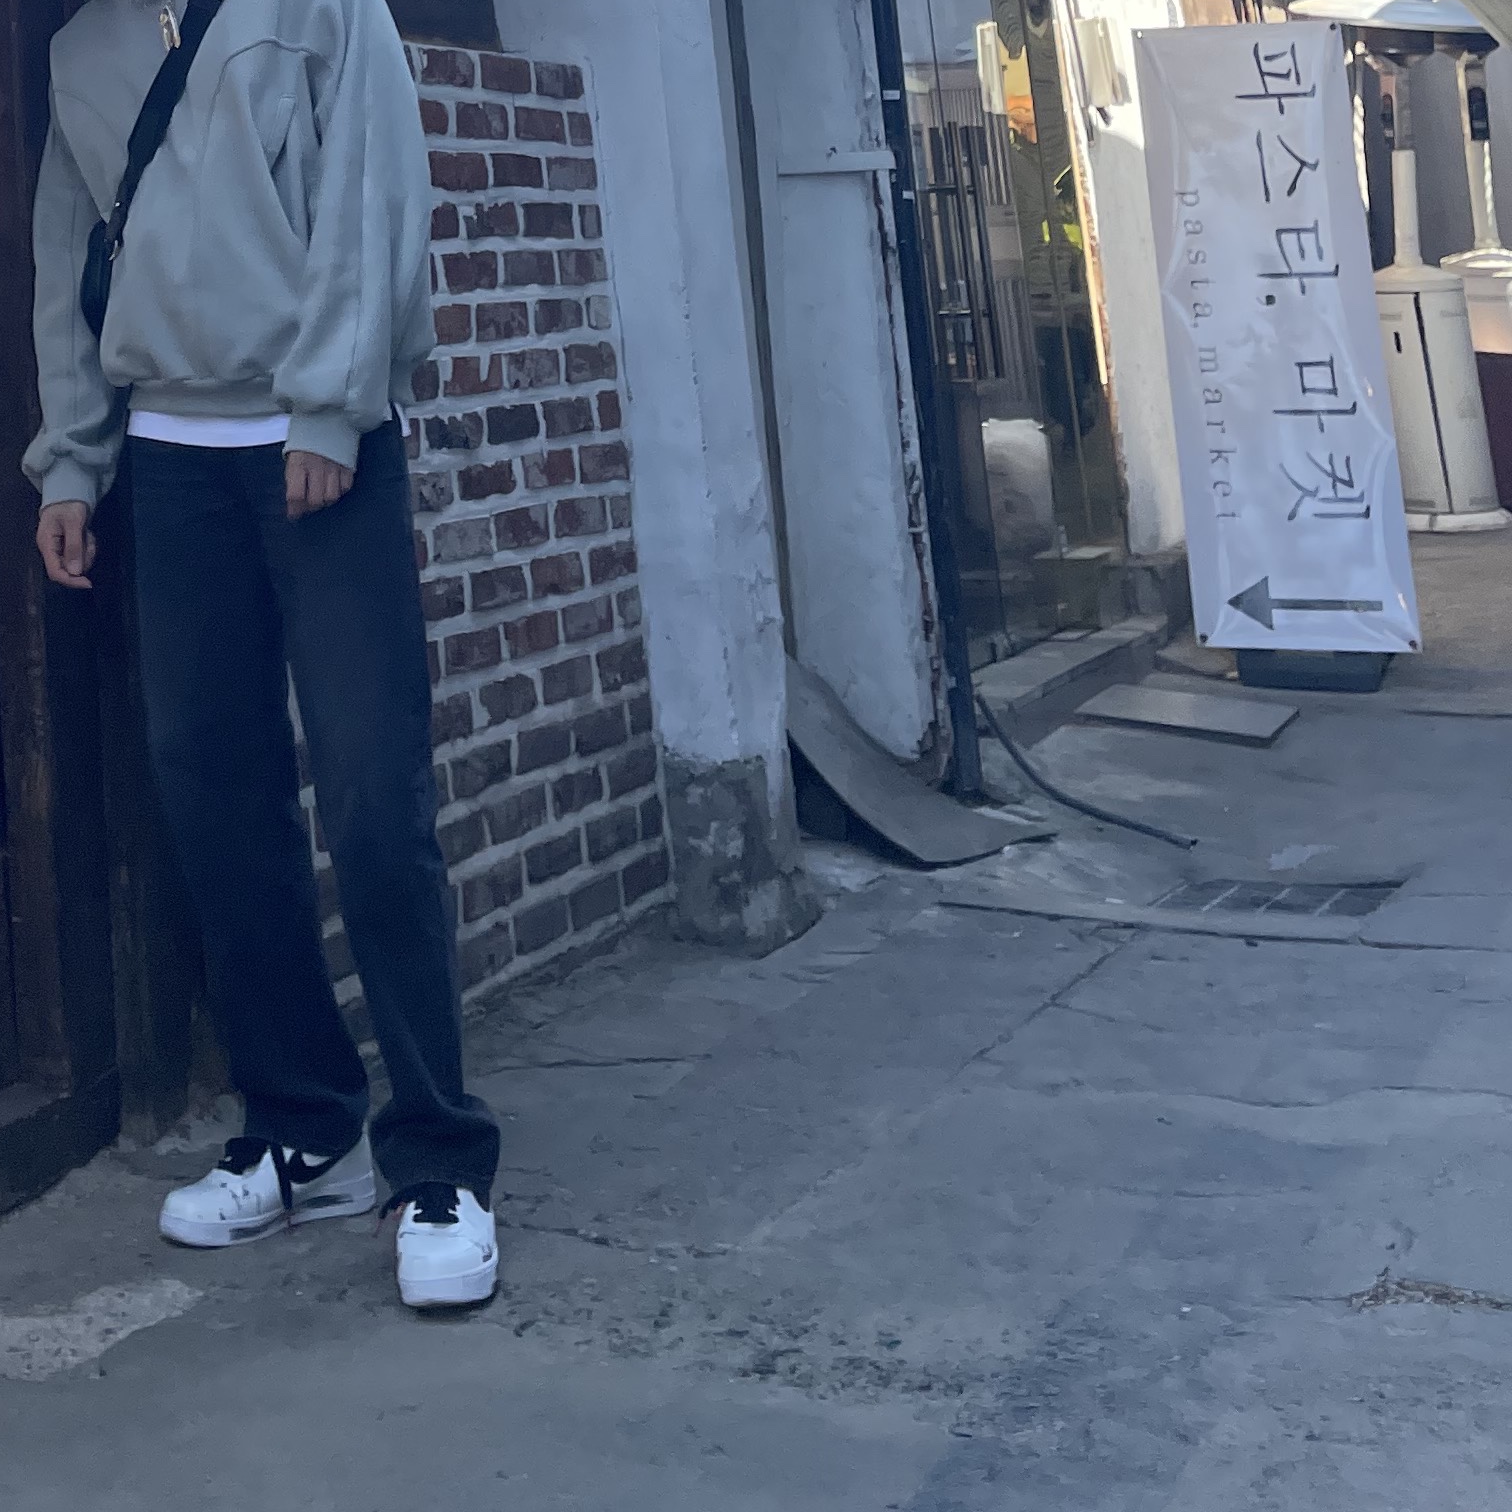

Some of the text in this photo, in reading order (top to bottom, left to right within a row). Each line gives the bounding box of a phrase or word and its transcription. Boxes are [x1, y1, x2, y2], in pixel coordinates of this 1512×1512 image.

[1198, 347, 1242, 519] market
[1234, 41, 1371, 522] 파스타, 마켓
